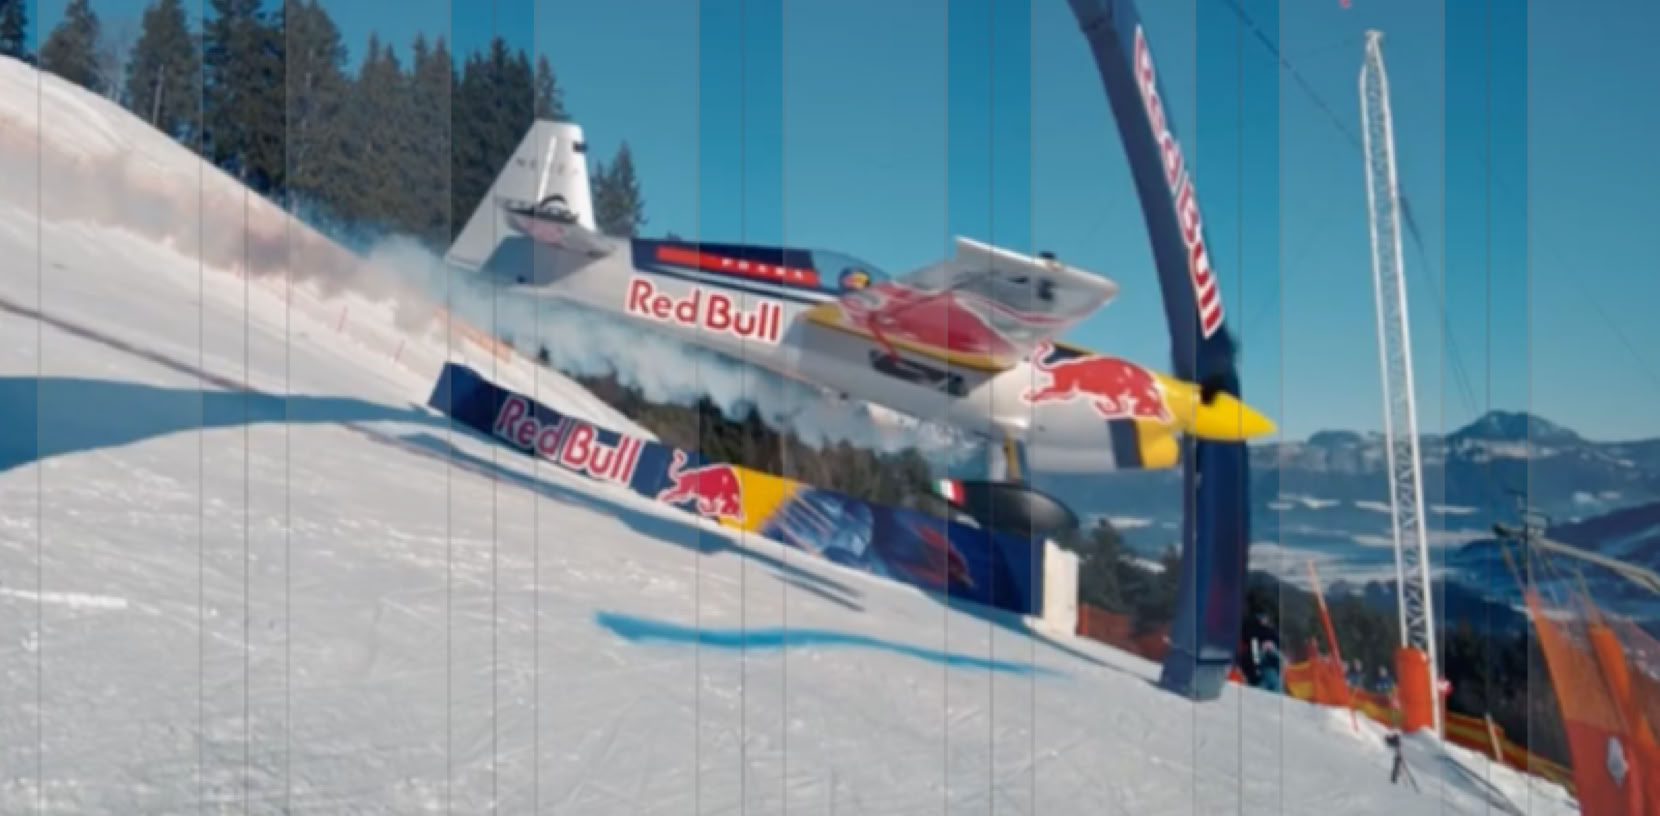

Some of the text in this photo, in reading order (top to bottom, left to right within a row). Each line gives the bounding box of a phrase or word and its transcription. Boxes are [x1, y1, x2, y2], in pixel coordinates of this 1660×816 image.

[1133, 25, 1224, 338] Red Bull
[628, 279, 782, 342] Red Bull
[496, 398, 642, 484] Red Bull
